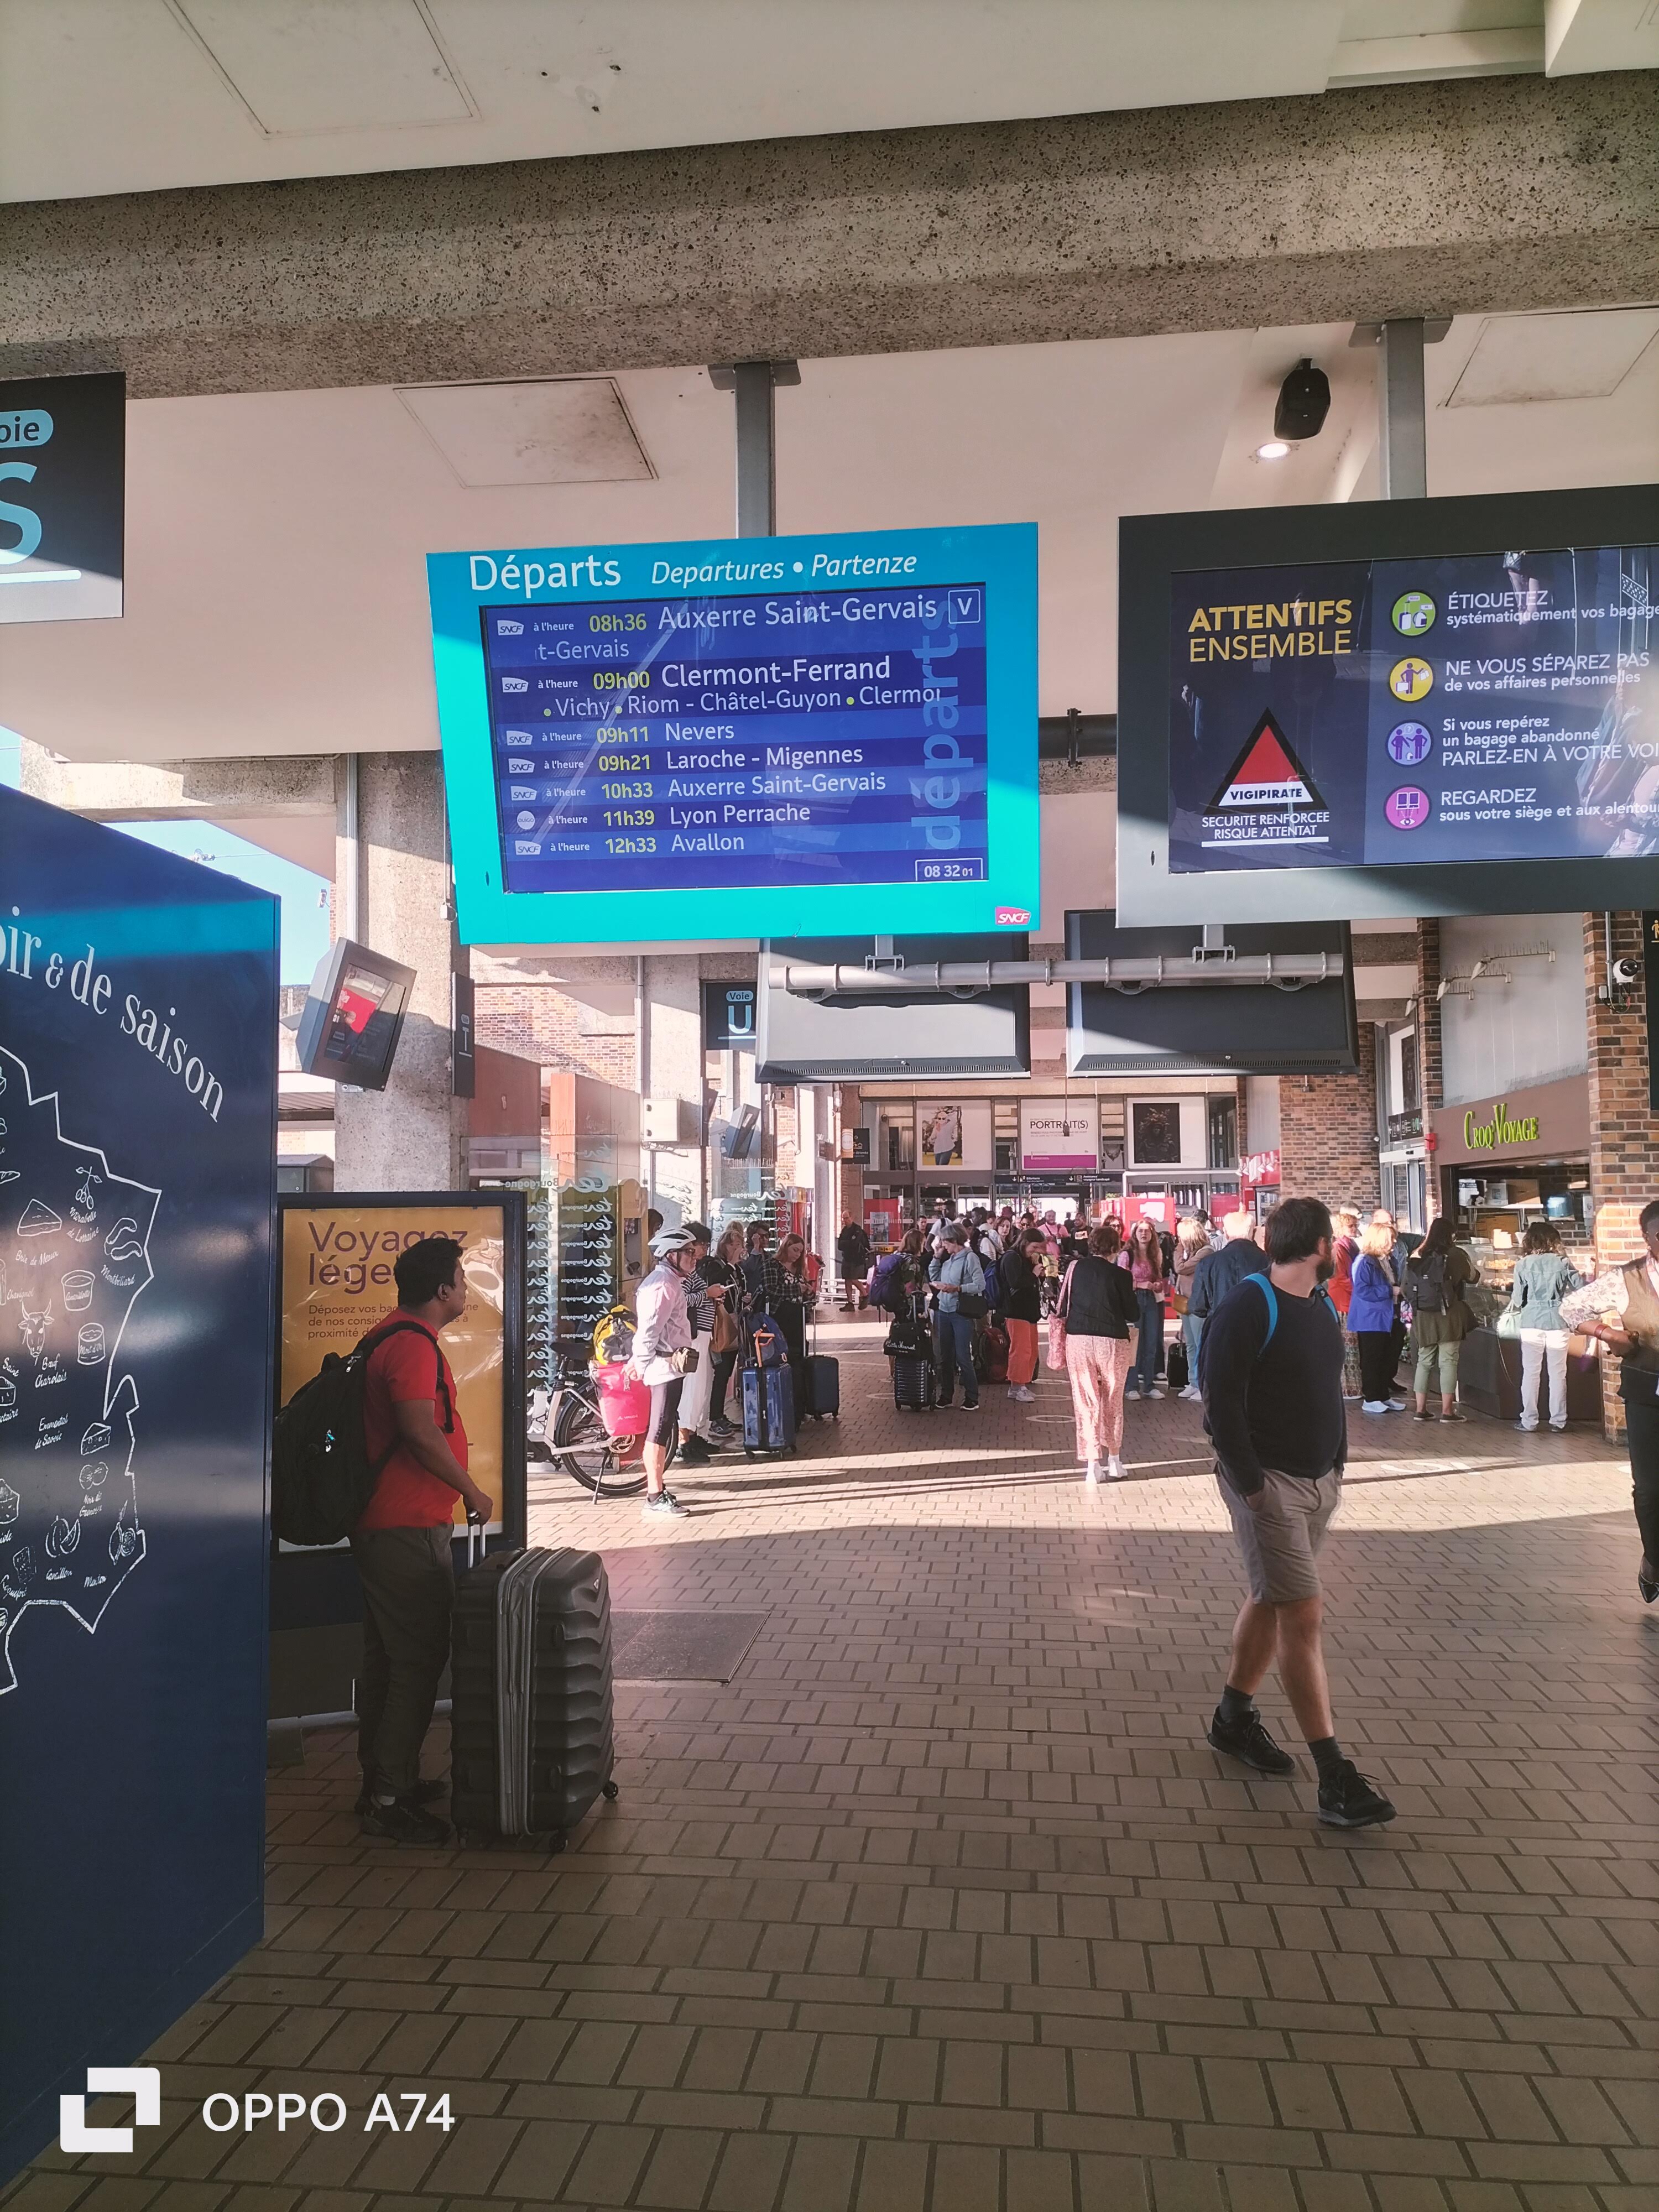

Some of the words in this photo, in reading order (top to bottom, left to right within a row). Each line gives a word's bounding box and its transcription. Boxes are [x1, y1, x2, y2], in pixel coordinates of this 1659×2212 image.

[469, 555, 621, 598] Départs
[651, 560, 784, 588] Departures
[811, 554, 917, 577] Partenze
[1448, 590, 1548, 609] ÉTIQUETEZ
[499, 623, 523, 635] SNCF
[533, 621, 539, 632] à
[541, 621, 574, 631] l'heure
[589, 613, 647, 633] 08h36
[659, 607, 756, 629] Auxerre
[765, 594, 937, 625] Saint-Gervais
[957, 597, 972, 615] V
[1188, 599, 1352, 632] ATTENTIFS
[1447, 606, 1576, 628] systématiquement
[1581, 607, 1605, 618] vos
[535, 639, 629, 660] t-Gervais
[1190, 629, 1351, 662] ENSEMBLE
[503, 680, 528, 692] SNCF
[538, 679, 544, 689] à
[546, 679, 578, 689] l'heure
[593, 671, 650, 690] 09h00
[661, 655, 891, 688] Clermont-Ferrand
[1446, 661, 1470, 676] NE
[1477, 658, 1526, 674] VOUS
[1532, 653, 1610, 671] SÉPAREZ
[1618, 653, 1650, 667] PAS
[1445, 679, 1462, 691] de
[1467, 680, 1490, 691] vos
[1495, 674, 1546, 689] affaires
[1552, 671, 1640, 690] personnelles
[555, 697, 611, 719] Vichy
[628, 695, 679, 714] Riom
[700, 690, 841, 712] Châtel-Guyon
[508, 734, 531, 744] SNCF
[542, 732, 547, 742] à
[550, 732, 582, 742] l'heure
[597, 726, 649, 744] 09h11
[666, 722, 734, 741] Nevers
[911, 600, 974, 851] départs
[1443, 718, 1455, 731] Si
[1460, 719, 1491, 730] vous
[1496, 715, 1550, 729] repérez
[1443, 735, 1459, 747] un
[1464, 732, 1516, 749] bagage
[1521, 728, 1600, 744] abandonné
[510, 763, 533, 772] SNCF
[544, 760, 550, 770] à
[552, 759, 584, 769] l'heure
[599, 754, 650, 771] 09h21
[667, 750, 745, 769] Laroche
[766, 747, 863, 769] Migennes
[1443, 747, 1538, 766] PARLEZ-EN
[1543, 744, 1557, 763] À
[1562, 744, 1621, 761] VOTRE
[513, 790, 536, 800] SNCF
[546, 787, 552, 797] à
[554, 787, 586, 797] l'heure
[602, 782, 653, 799] 10h33
[668, 778, 745, 797] Auxerre
[752, 771, 886, 795] Saint-Gervais
[1230, 788, 1302, 800] VIGIPIRATE
[1441, 788, 1537, 805] REGARDEZ
[549, 815, 554, 825] à
[556, 815, 588, 825] l'heure
[603, 809, 655, 827] 11h39
[670, 807, 717, 829] Lyon
[724, 804, 811, 823] Perrache
[1202, 815, 1256, 827] SECURITE
[1260, 812, 1329, 826] RENFORCEE
[1439, 810, 1470, 821] sous
[1475, 808, 1511, 820] votre
[1515, 805, 1552, 821] siège
[1557, 805, 1572, 816] et
[1576, 806, 1600, 816] aux
[1214, 827, 1257, 839] RISQUE
[1260, 825, 1317, 837] ATTENTAT
[517, 846, 540, 855] SNCF
[550, 843, 556, 852] à
[558, 842, 590, 852] l'heure
[605, 837, 657, 854] 12h33
[671, 833, 744, 852] Avallon
[924, 865, 941, 878] 08
[944, 864, 960, 877] 32
[998, 912, 1030, 924] SNCF
[729, 992, 750, 1000] Voie
[728, 1005, 751, 1034] U
[71, 943, 111, 1015] de
[120, 994, 223, 1123] saison
[70, 1207, 97, 1223] Mirabelle
[75, 1227, 100, 1243] Lorraine
[15, 1250, 28, 1264] Brie
[30, 1256, 37, 1265] de
[39, 1250, 59, 1266] Meaux
[309, 1305, 355, 1316] Déposez
[308, 1327, 358, 1340] proximité
[3, 1357, 20, 1376] Saint
